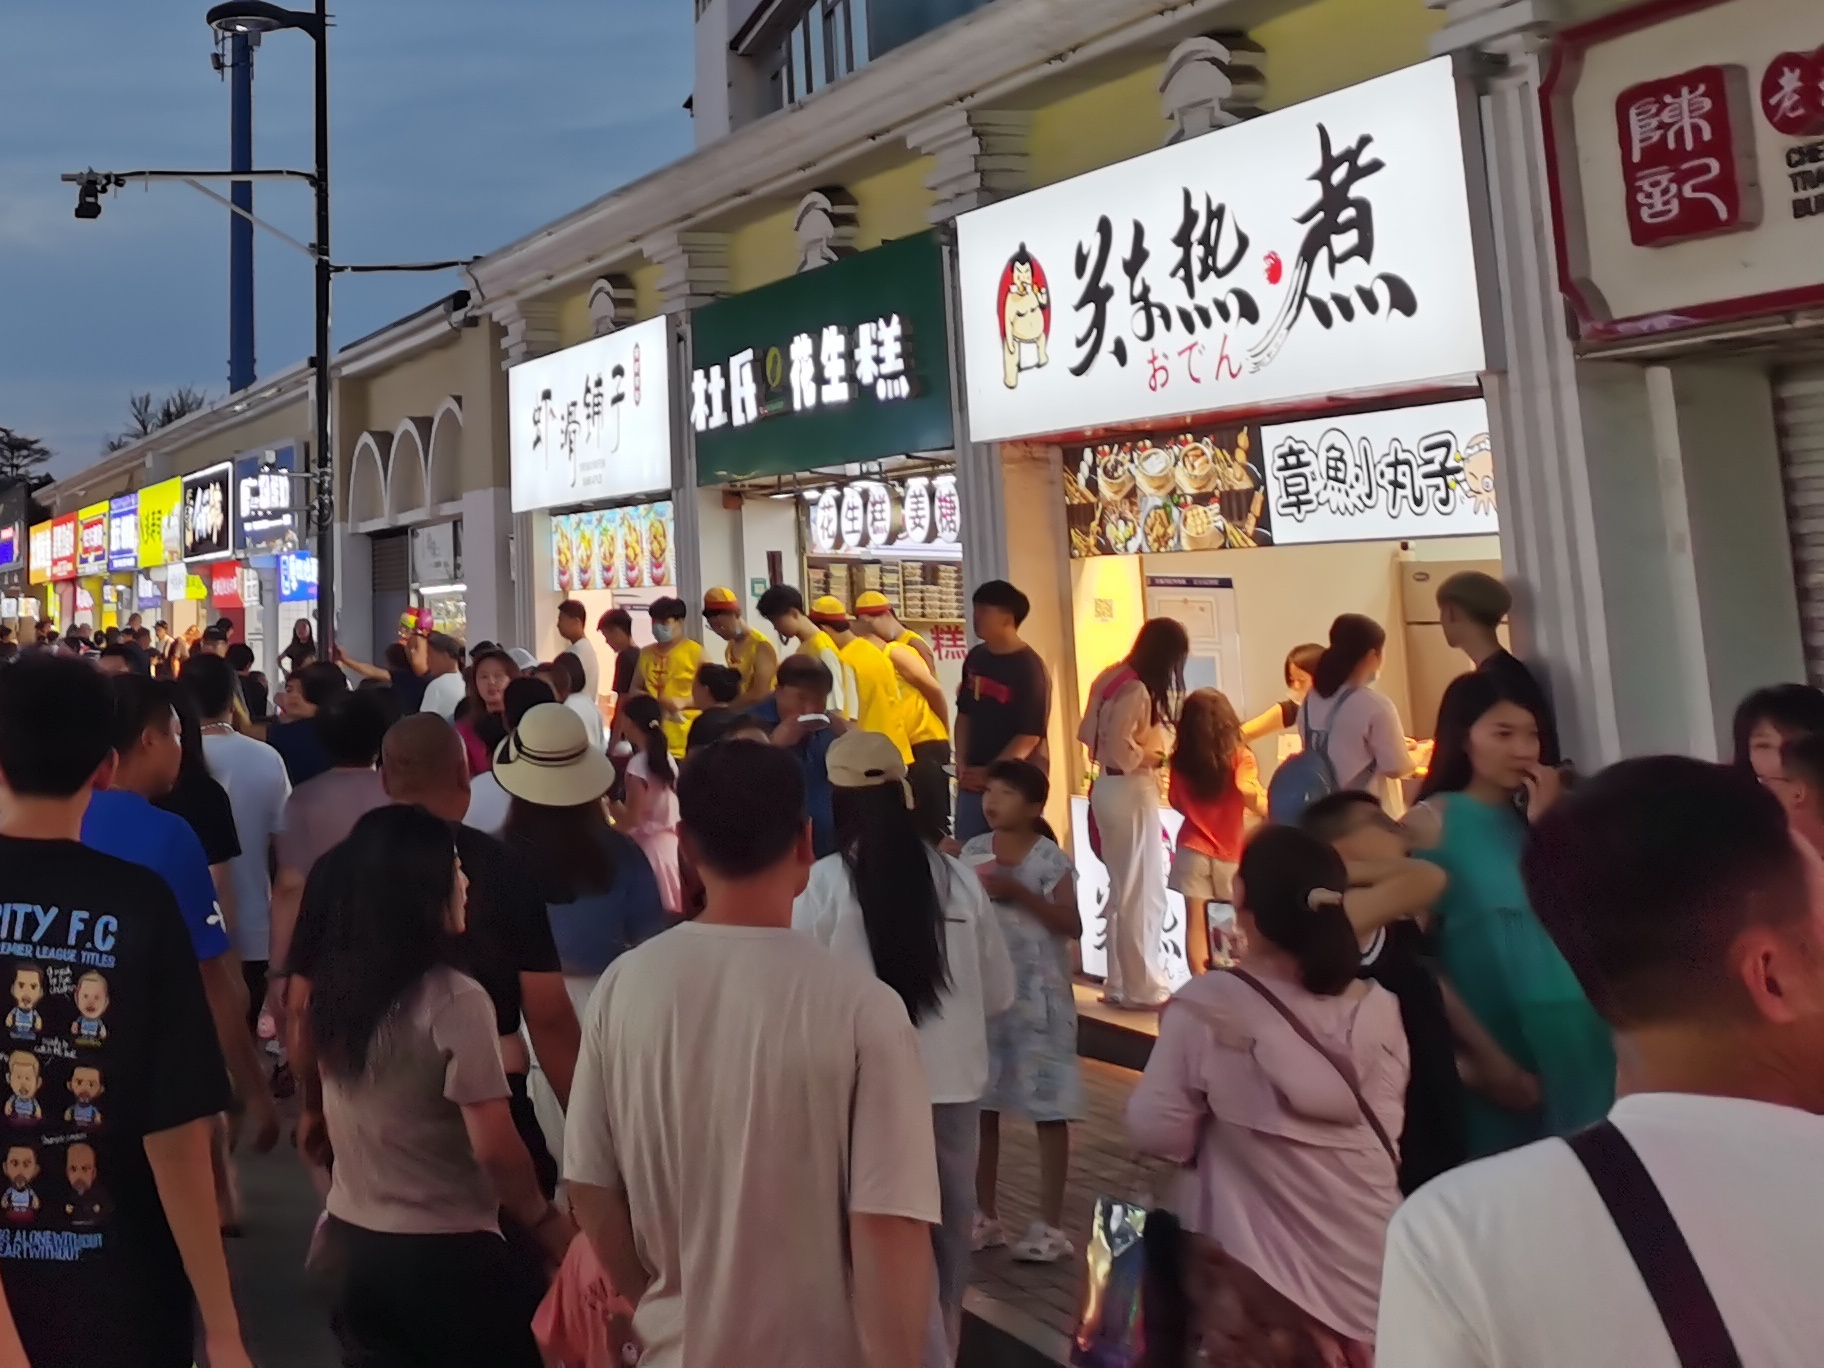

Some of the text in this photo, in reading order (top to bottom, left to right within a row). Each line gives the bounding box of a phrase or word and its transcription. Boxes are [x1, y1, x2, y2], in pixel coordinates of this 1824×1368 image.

[1769, 66, 1824, 123] 老
[1629, 83, 1728, 224] 陳記
[790, 313, 910, 412] 花生糕
[1147, 334, 1243, 392] おでん
[532, 364, 625, 487] 虾滑铺子
[820, 496, 887, 539] 花生糕
[930, 624, 968, 661] 糕
[36, 945, 76, 963] LEAGUE
[67, 910, 118, 952] F.C
